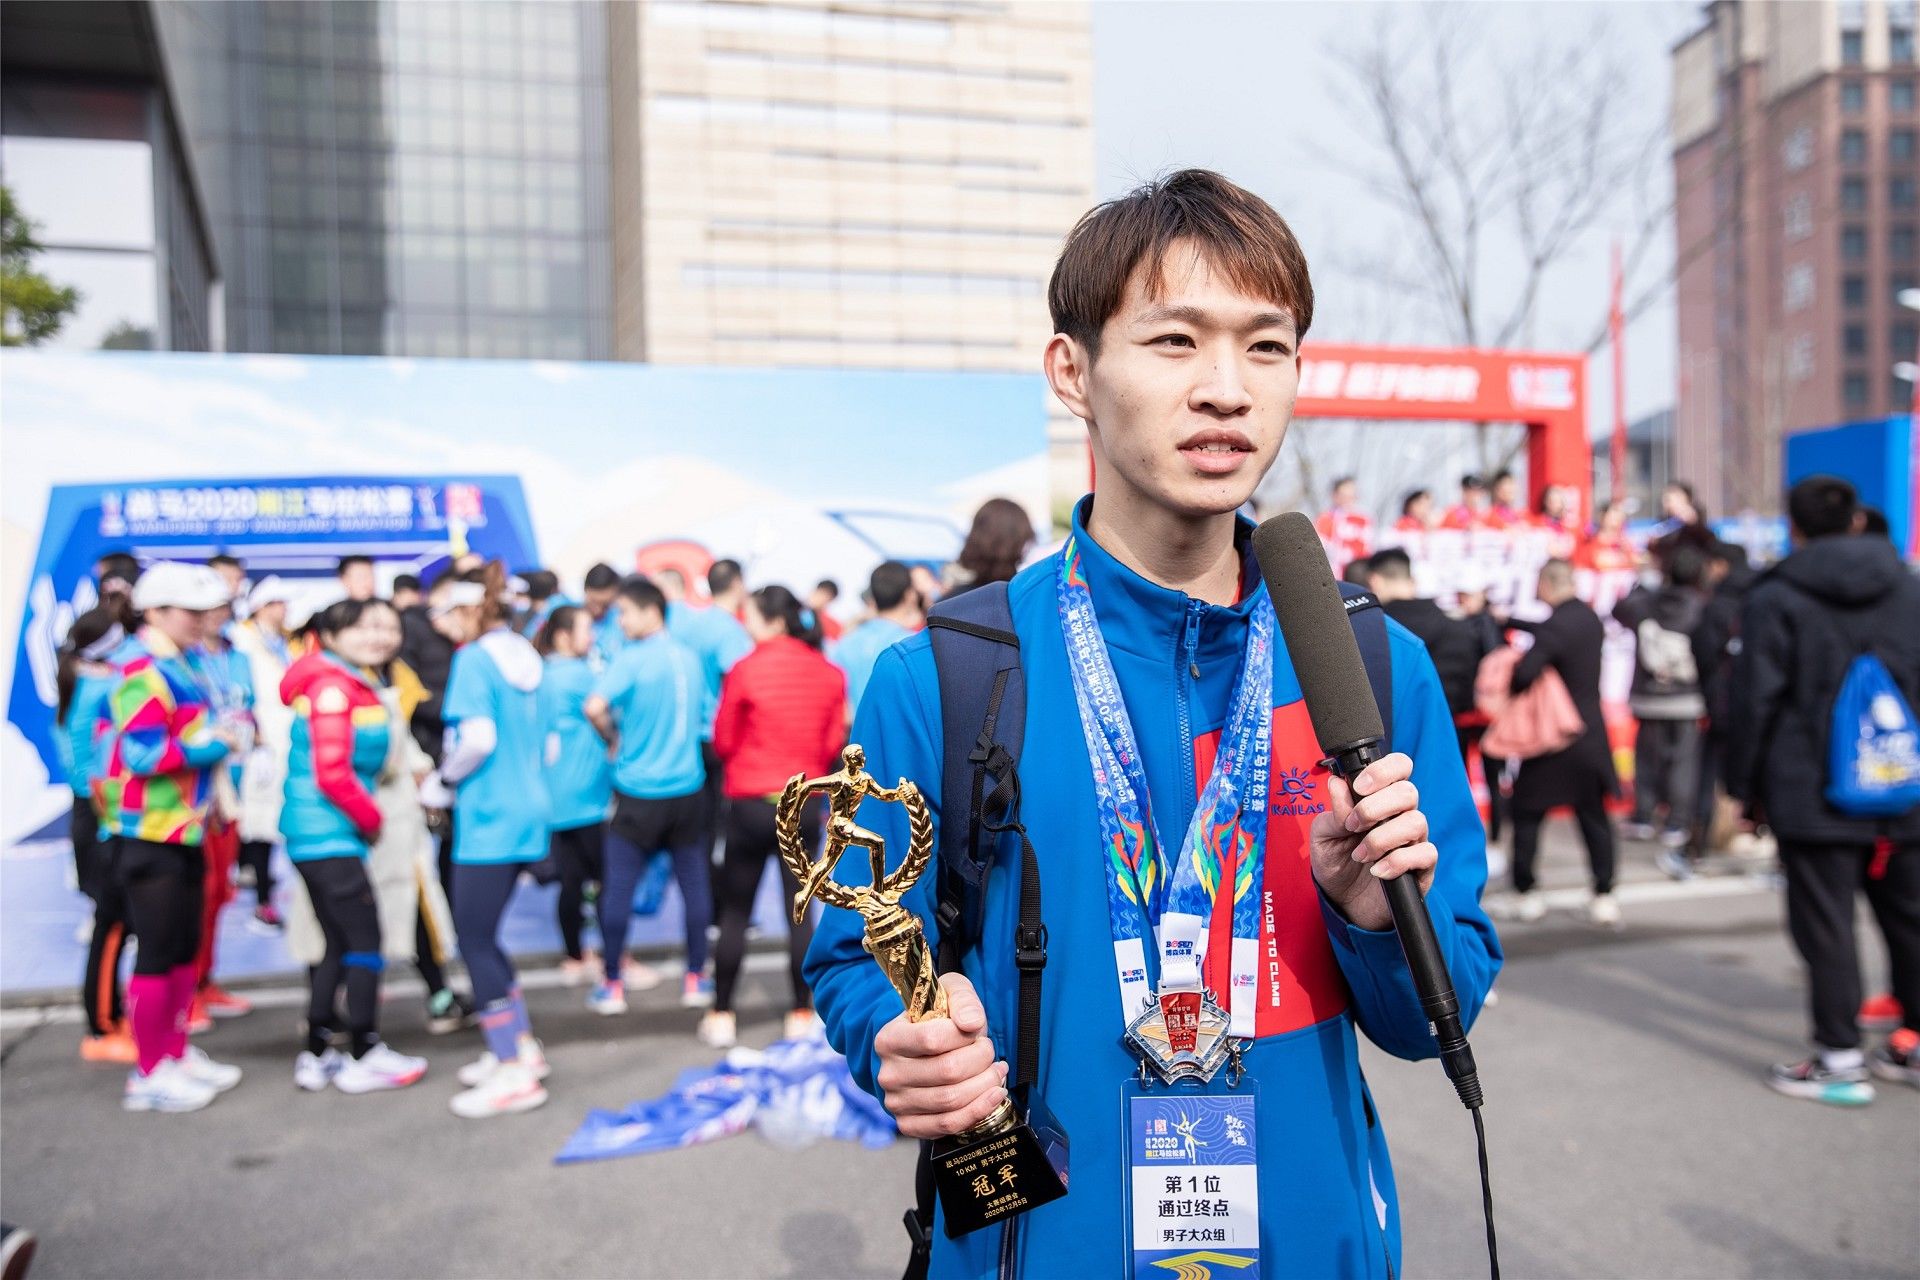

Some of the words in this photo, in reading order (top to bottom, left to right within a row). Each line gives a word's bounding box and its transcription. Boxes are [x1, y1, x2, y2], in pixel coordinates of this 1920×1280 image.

[1344, 596, 1370, 609] AILAS
[1233, 727, 1251, 775] WARHORSE
[1271, 802, 1325, 816] KAILAS
[1264, 891, 1275, 934] MADE
[1267, 938, 1278, 958] TO
[1269, 962, 1281, 1007] CLIMB
[980, 1147, 1017, 1168] 男子大众组
[971, 1163, 1018, 1199] 冠军
[1165, 1176, 1221, 1193] 第1位
[1158, 1199, 1230, 1217] 通过终点
[1163, 1229, 1226, 1242] 男子大众组
